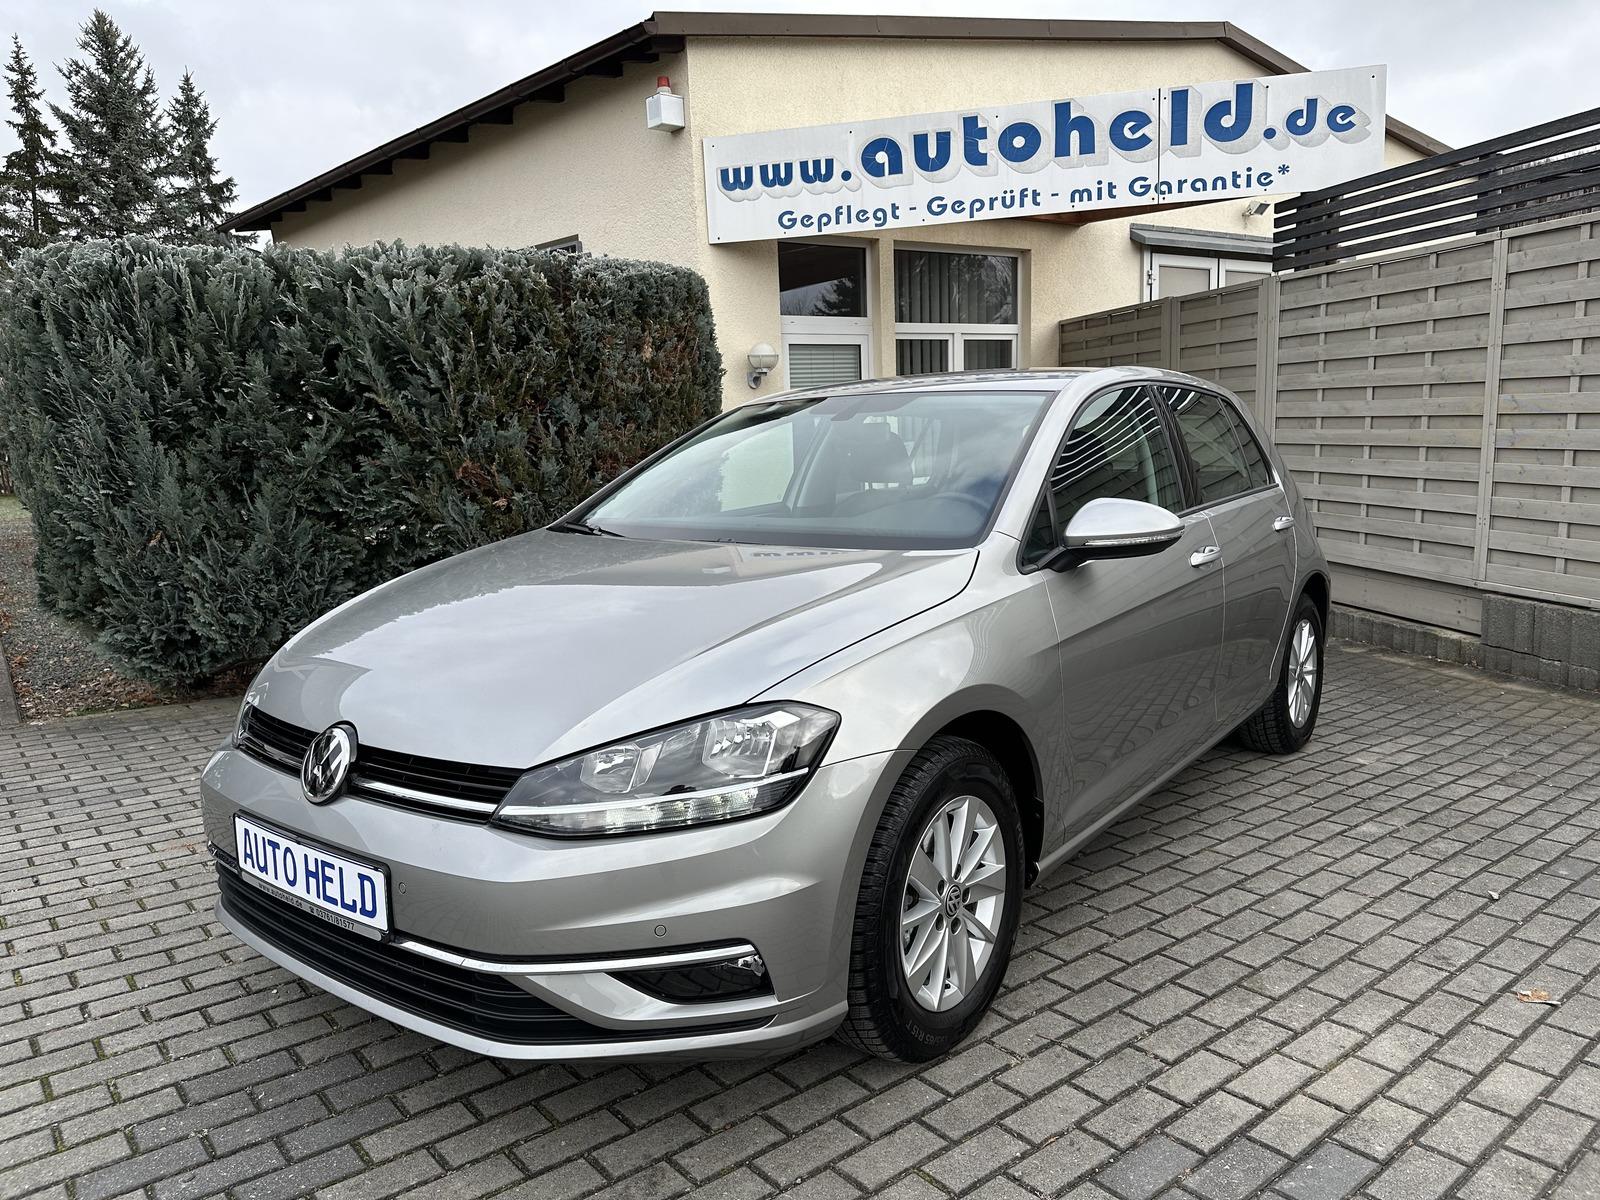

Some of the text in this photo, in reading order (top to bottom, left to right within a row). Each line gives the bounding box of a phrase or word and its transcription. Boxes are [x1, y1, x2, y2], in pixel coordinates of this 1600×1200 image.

[719, 83, 1356, 192] www.autoheld.de
[778, 202, 901, 232] Gepflegt
[927, 186, 1041, 219] Geprüft
[1071, 178, 1117, 203] mit
[243, 828, 377, 919] AUTO HELD
